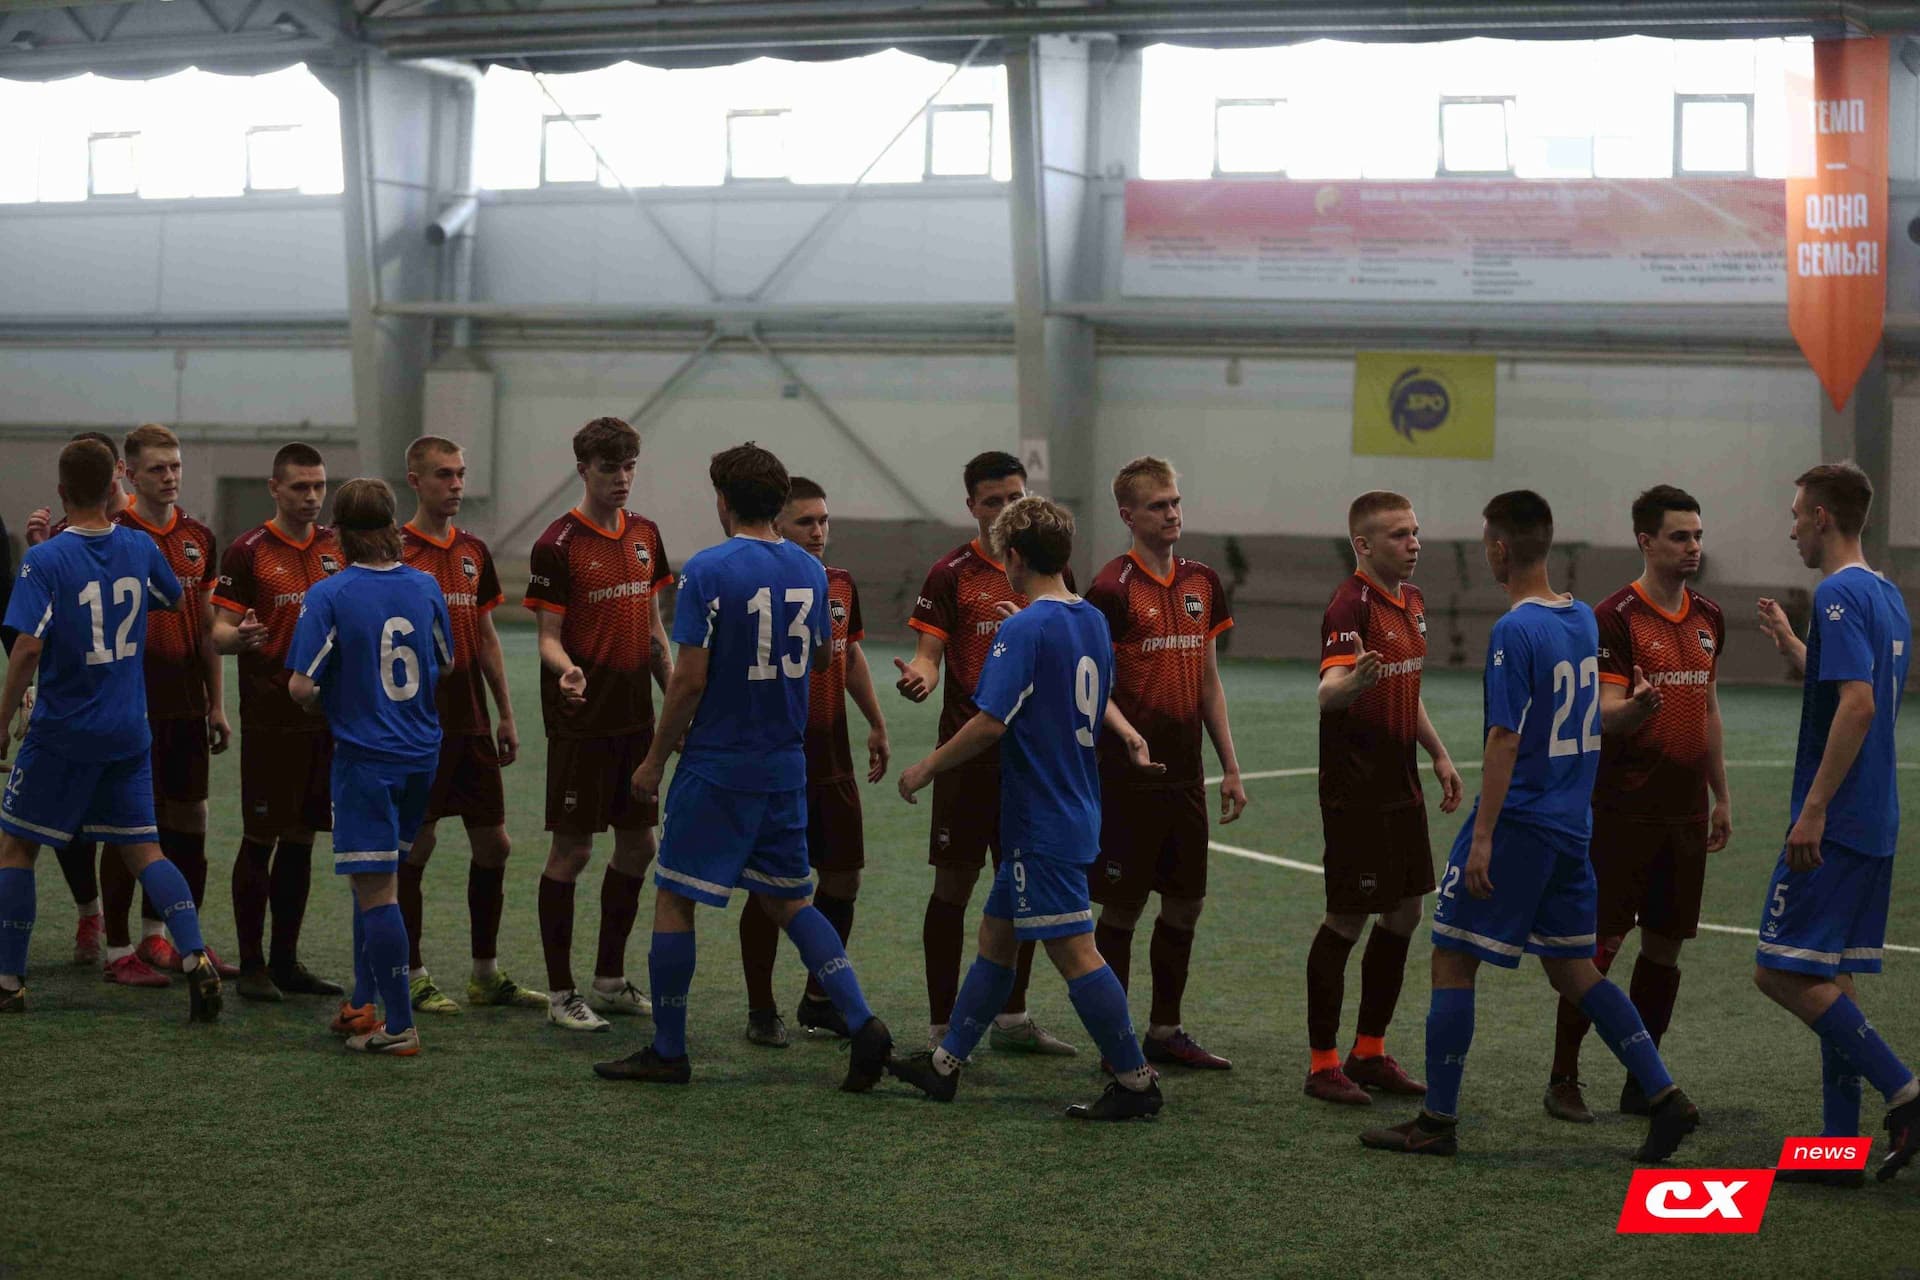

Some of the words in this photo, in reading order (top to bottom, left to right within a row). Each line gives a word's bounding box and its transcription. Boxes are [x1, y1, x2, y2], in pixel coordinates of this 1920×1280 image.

[1806, 193, 1869, 234] ОДНА
[1797, 241, 1880, 277] СЕМЬЯ!
[78, 576, 142, 666] 12
[380, 616, 420, 701] 6
[747, 587, 814, 681] 13
[1075, 655, 1099, 748] 9
[1549, 656, 1602, 758] 22
[1013, 861, 1026, 893] 9
[1770, 882, 1790, 918] 5
